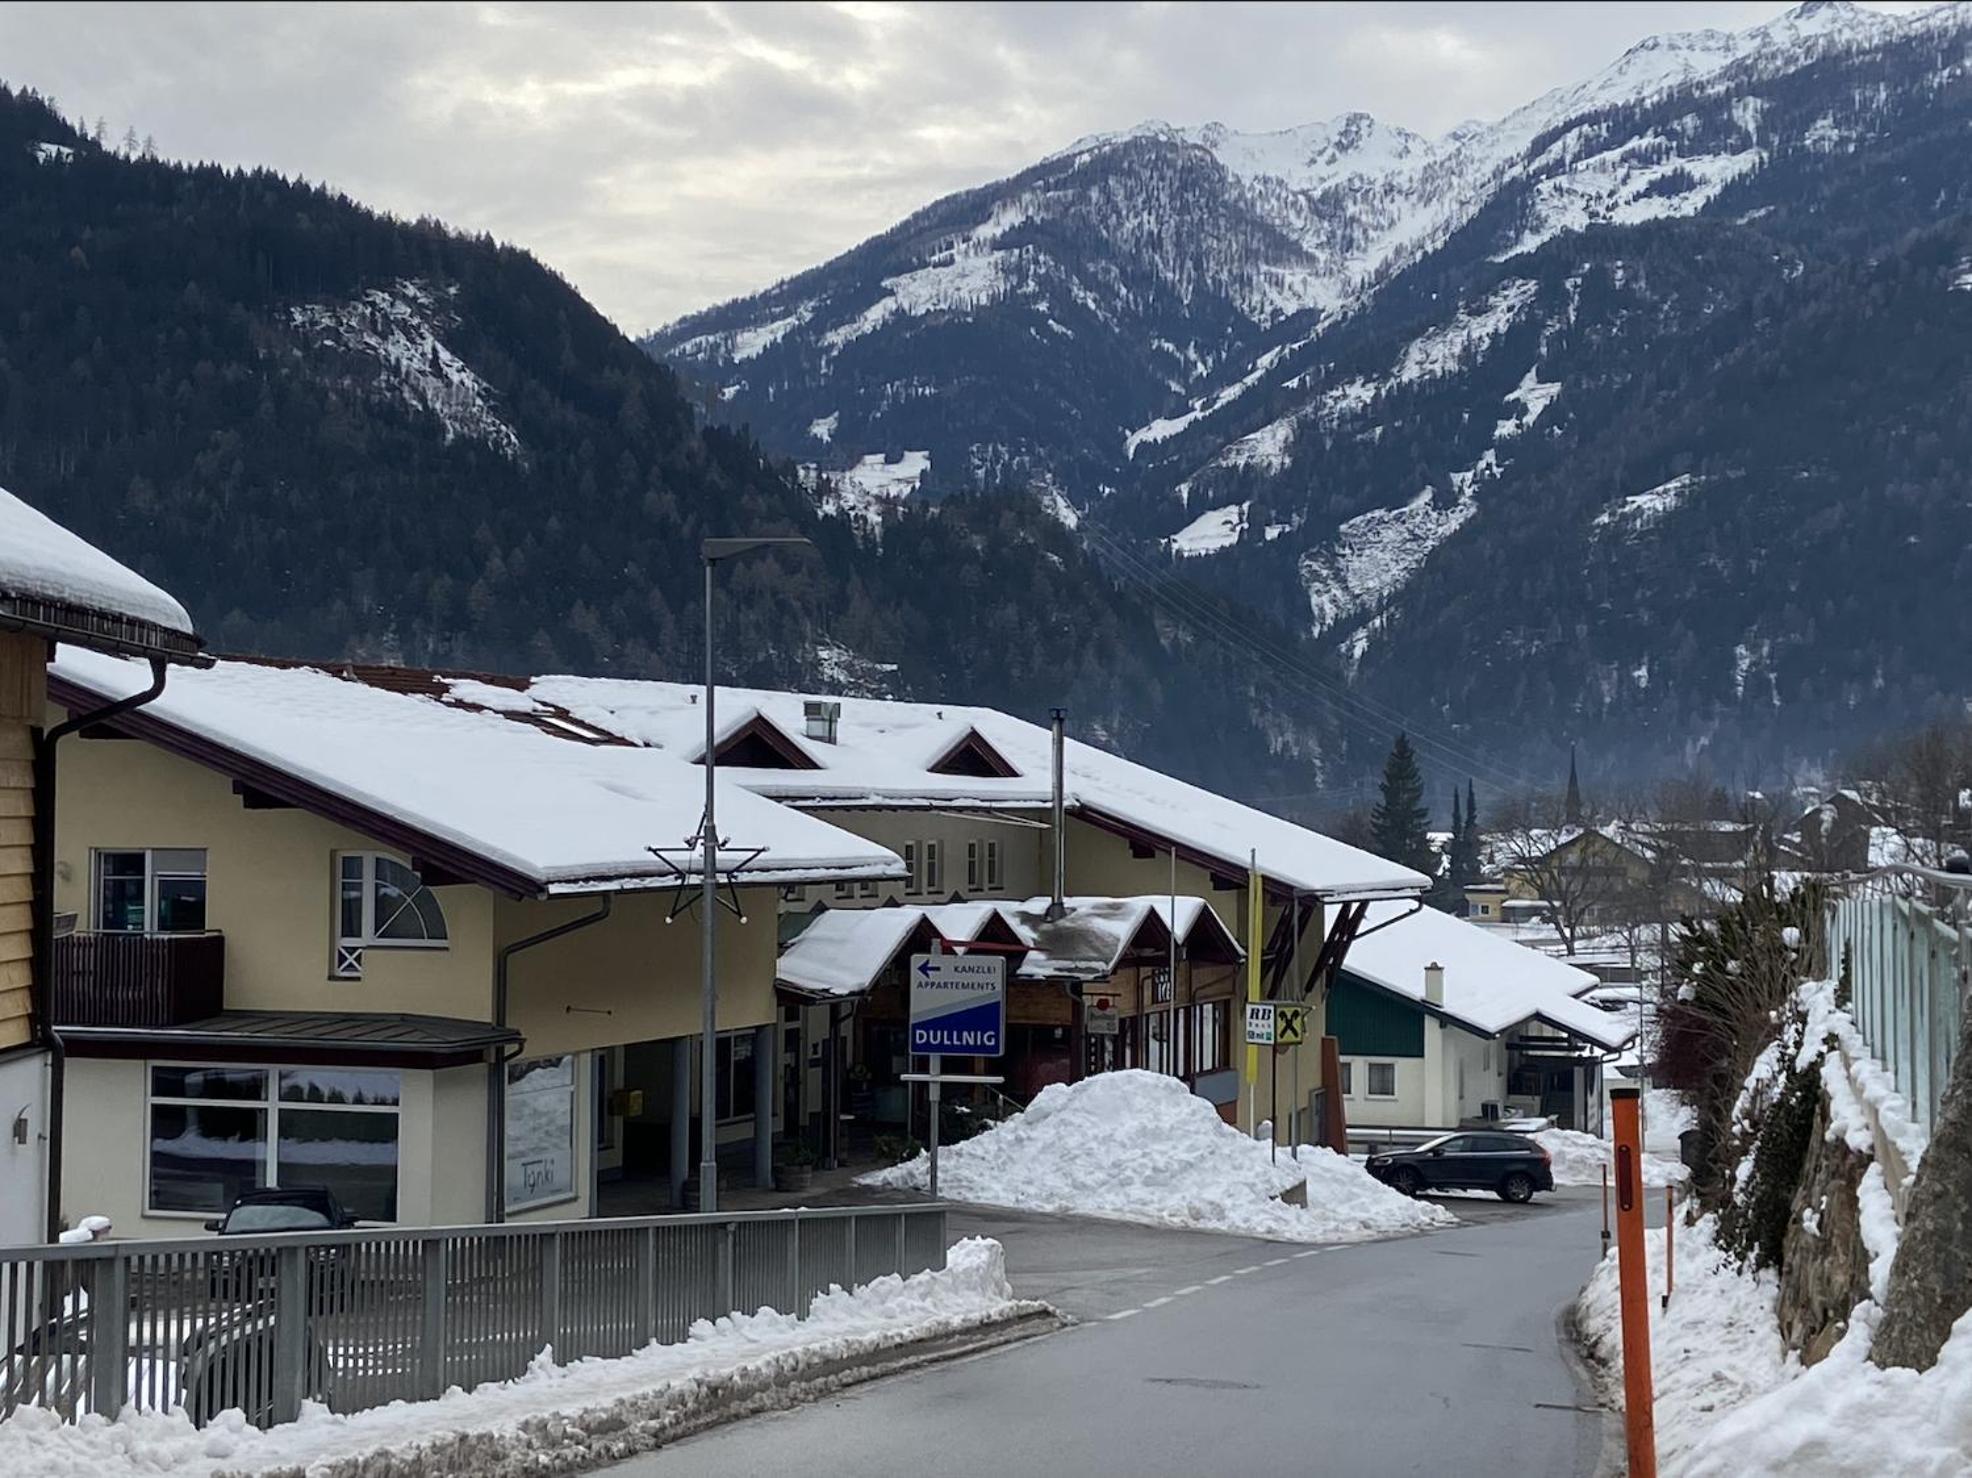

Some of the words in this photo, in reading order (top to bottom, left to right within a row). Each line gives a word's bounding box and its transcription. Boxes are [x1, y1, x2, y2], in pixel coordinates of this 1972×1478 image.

[954, 965, 996, 975] KANZLEI
[917, 981, 996, 991] APPARTEMENTS
[916, 1030, 996, 1045] DULLNIG
